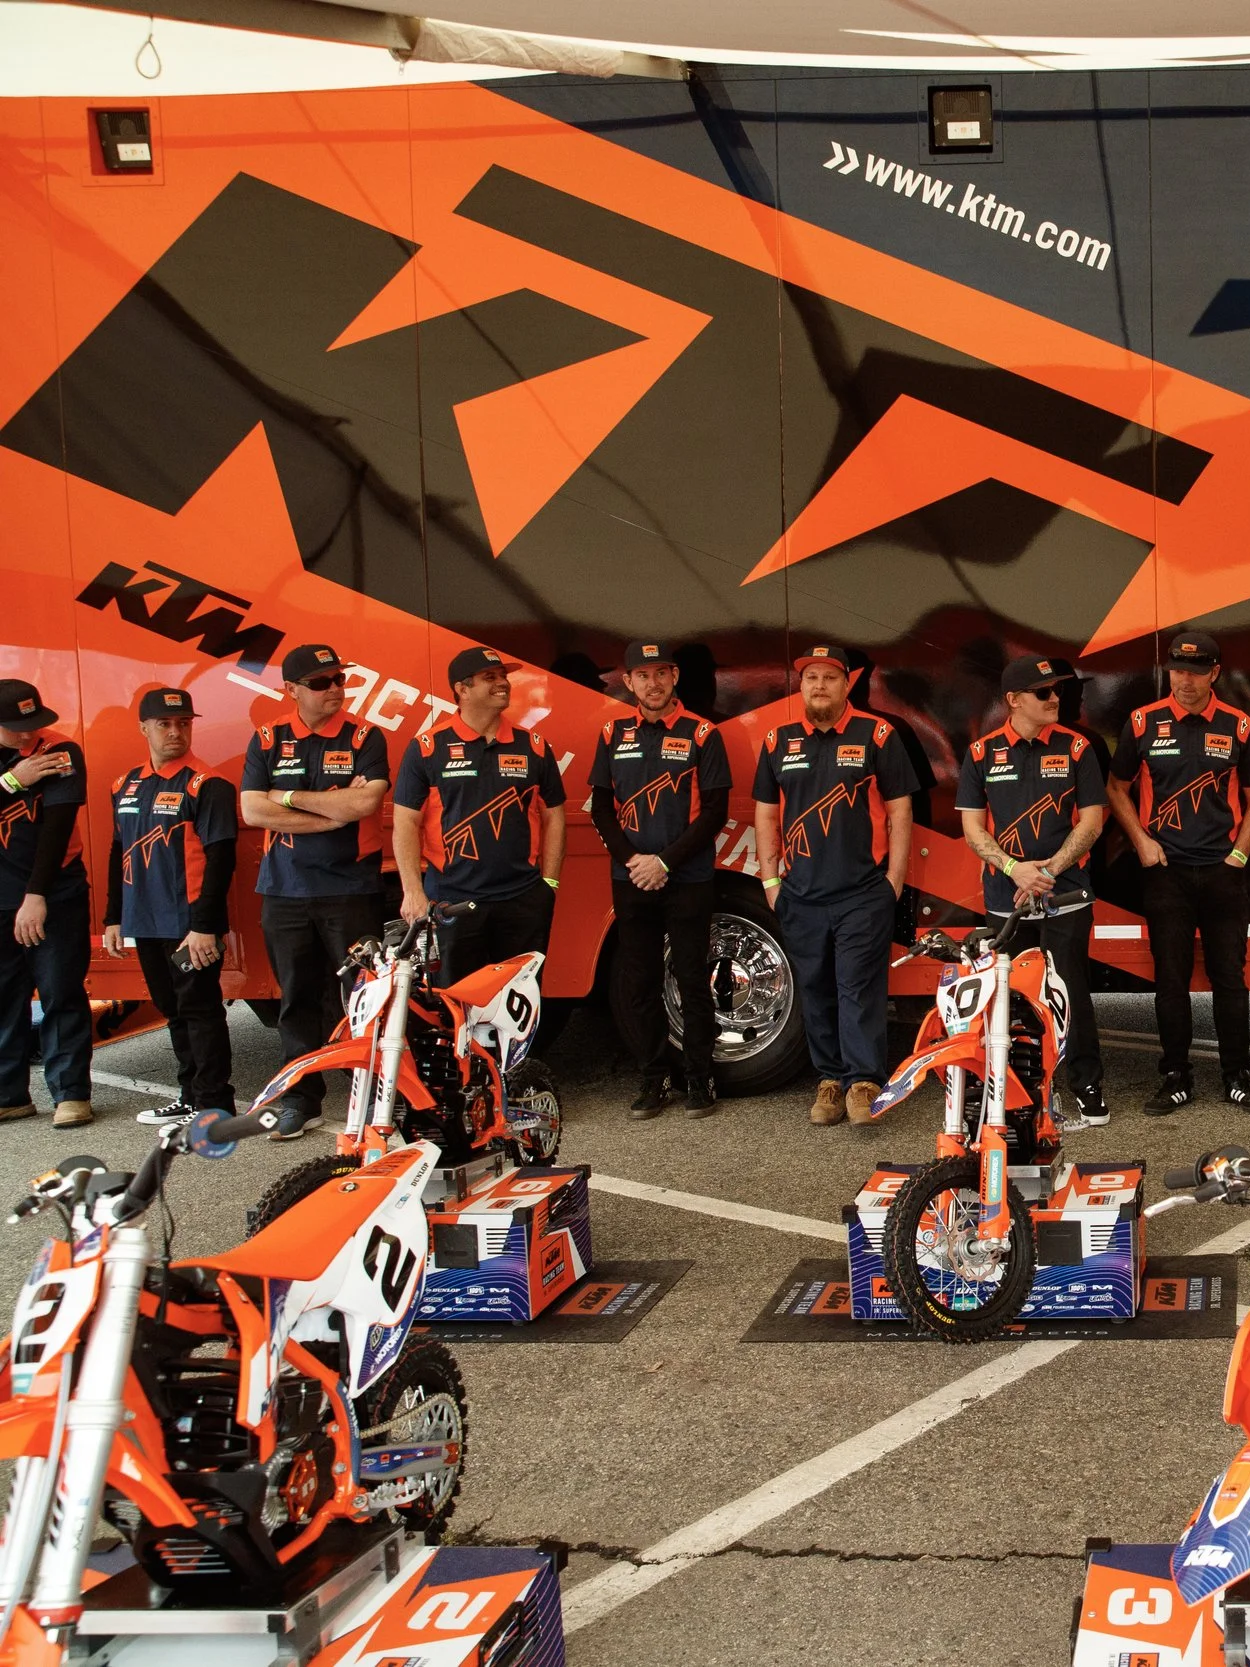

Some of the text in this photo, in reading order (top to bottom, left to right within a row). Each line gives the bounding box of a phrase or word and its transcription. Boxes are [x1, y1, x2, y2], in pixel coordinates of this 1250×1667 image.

[864, 152, 1112, 271] www.ktm.com
[75, 560, 286, 676] KTM
[507, 988, 533, 1033] 9
[411, 1161, 430, 1188] DUNLOP
[509, 1181, 553, 1192] 9
[362, 1225, 417, 1312] 2
[545, 1250, 561, 1268] KTM
[578, 1287, 613, 1310] KTM
[926, 1302, 953, 1324] DUNLOP
[1154, 1283, 1177, 1307] KTM
[14, 1281, 66, 1364] 2
[375, 1324, 404, 1364] MOTOREX
[1183, 1544, 1234, 1569] KTM
[406, 1591, 496, 1629] 2
[1107, 1587, 1172, 1626] 3
